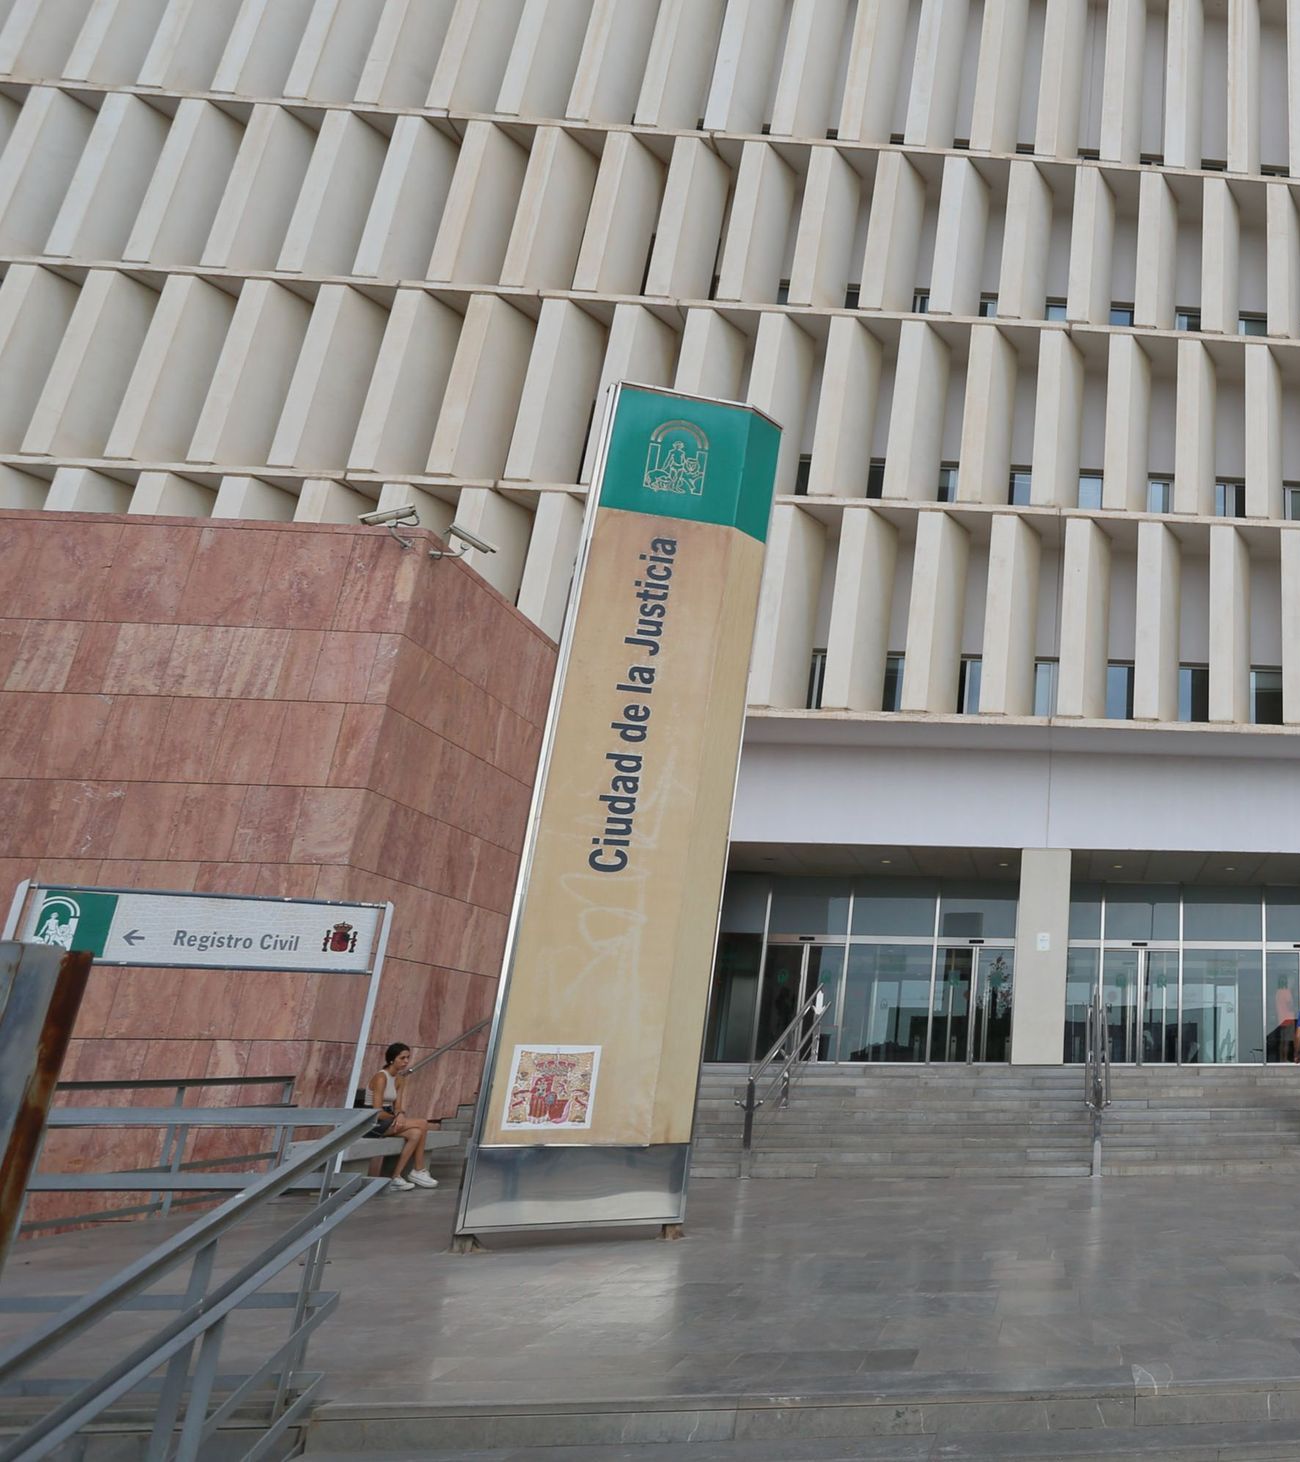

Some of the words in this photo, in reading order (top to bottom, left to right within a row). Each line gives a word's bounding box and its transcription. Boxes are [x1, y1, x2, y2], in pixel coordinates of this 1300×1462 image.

[624, 536, 678, 657] Justicia
[616, 666, 656, 695] la
[610, 704, 651, 743] de
[588, 753, 643, 872] Ciudad
[173, 930, 253, 952] Registro
[260, 934, 300, 951] Civil
